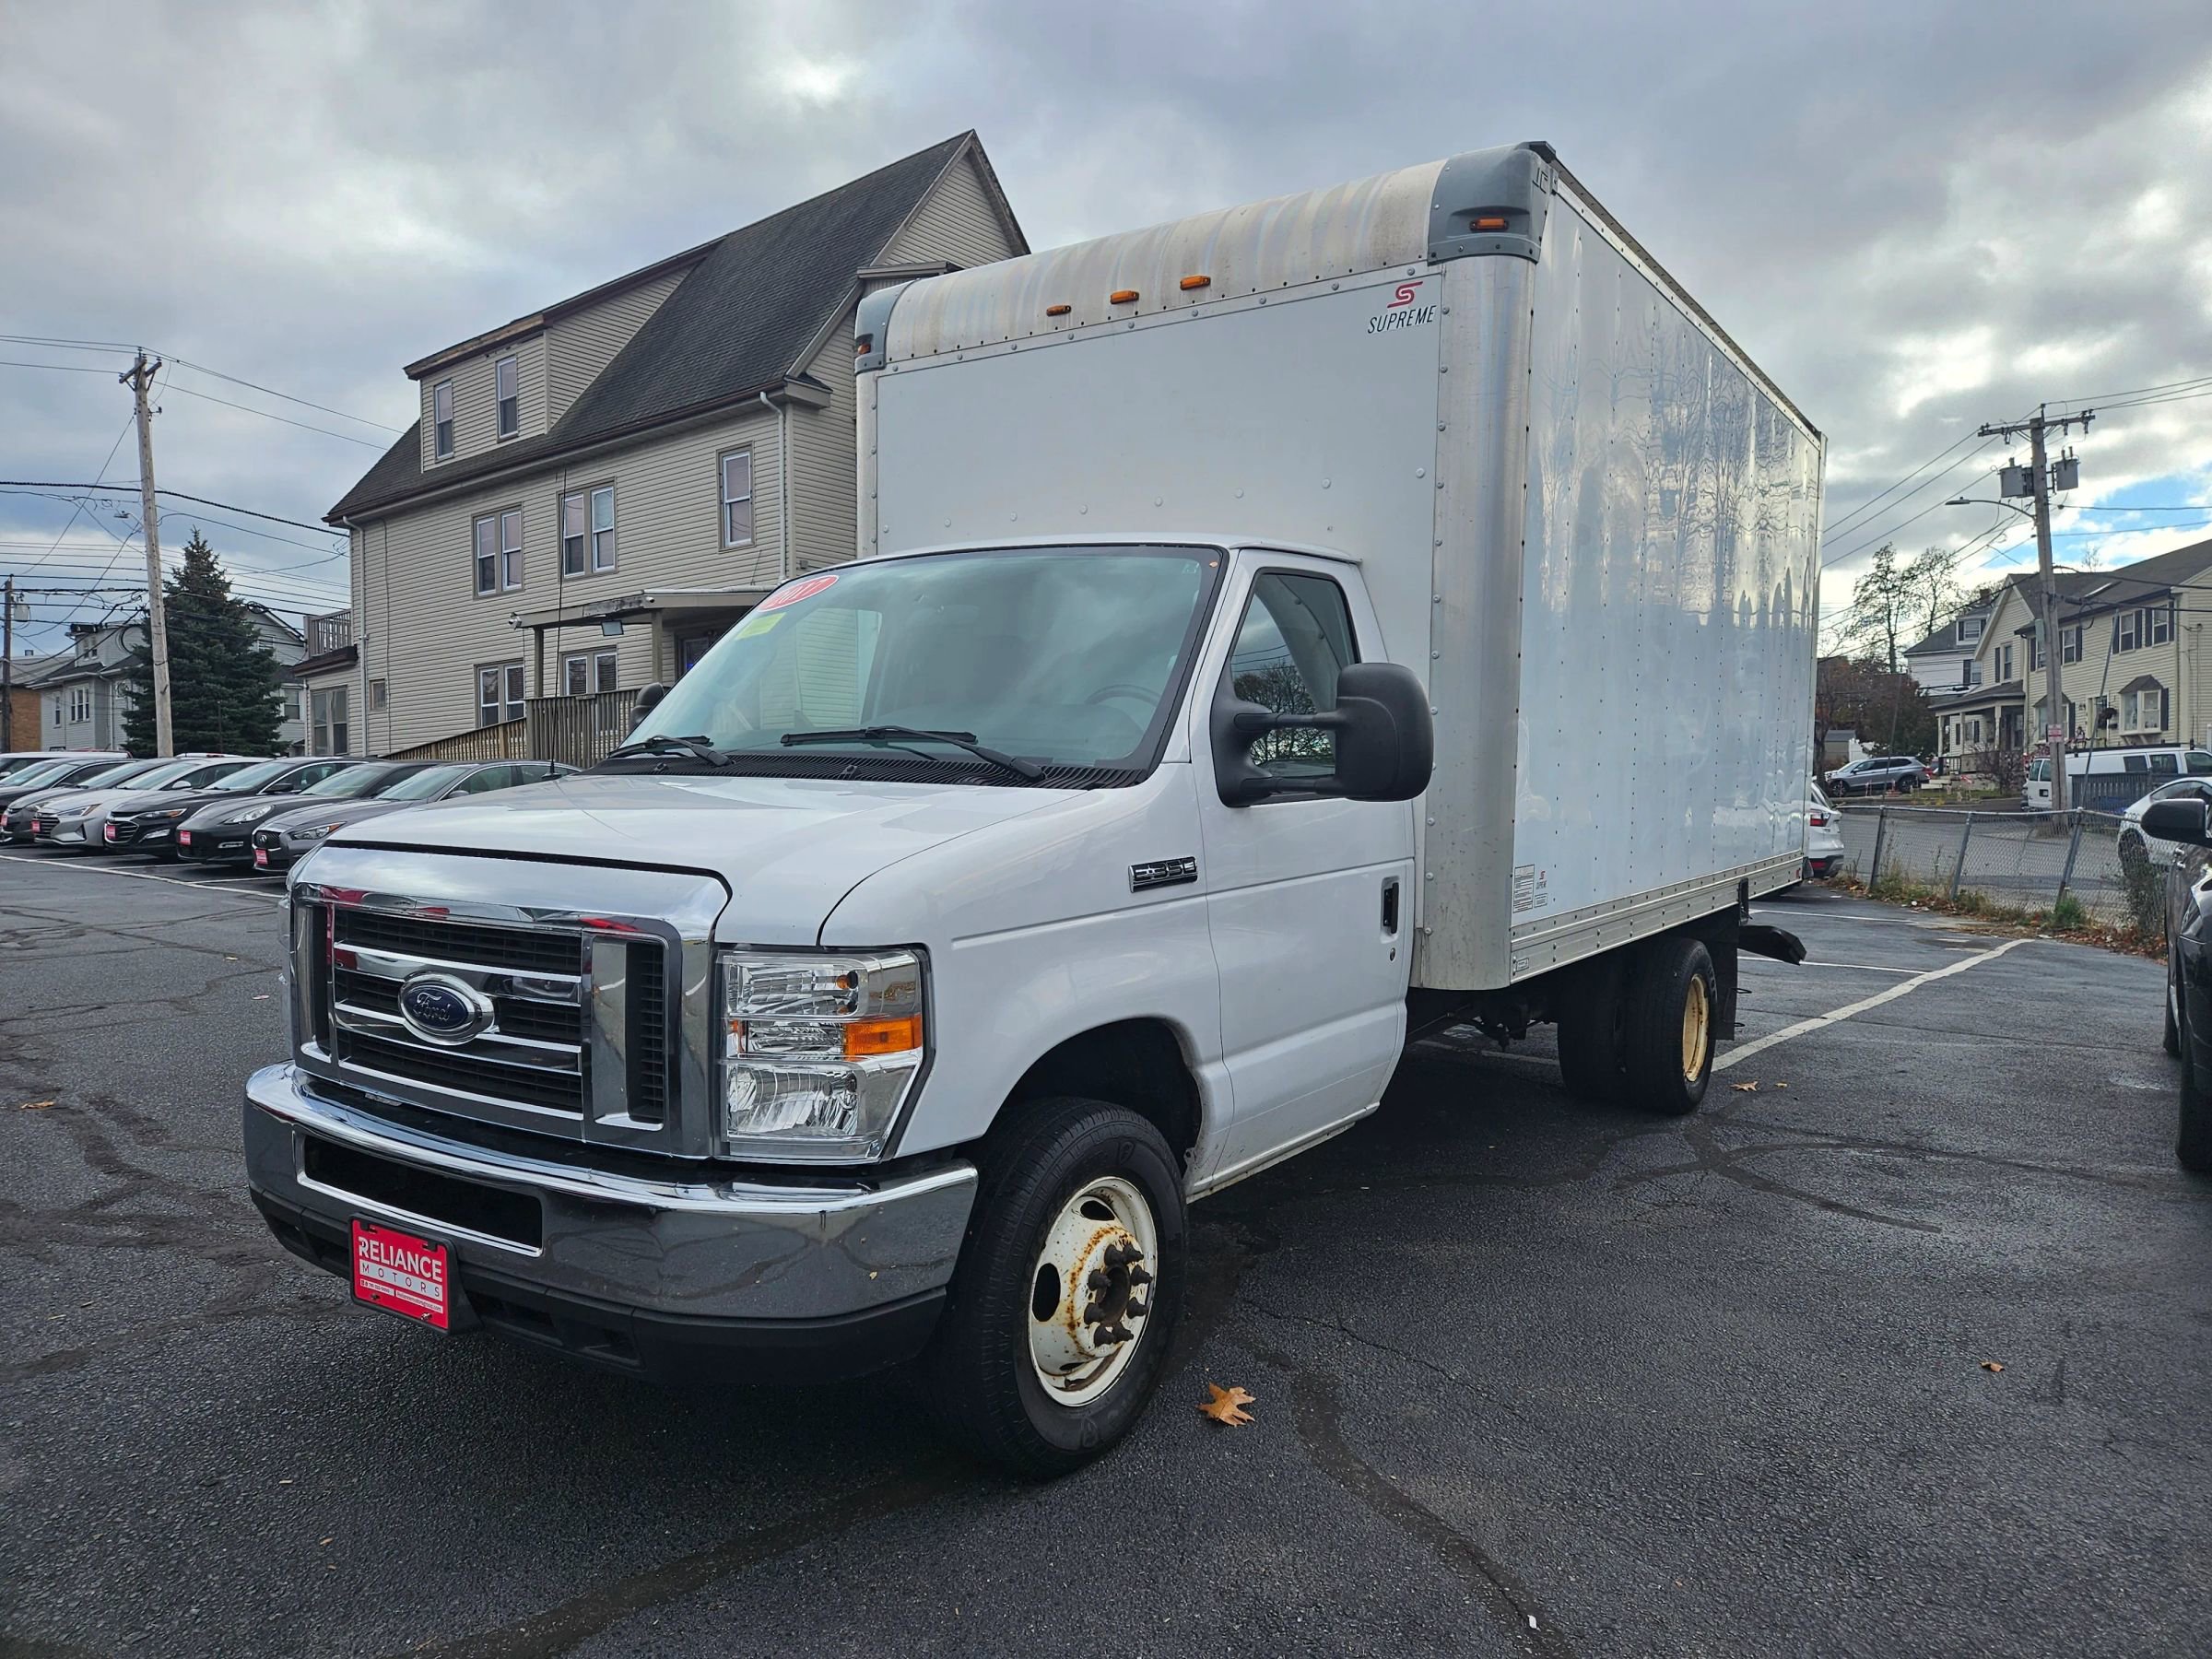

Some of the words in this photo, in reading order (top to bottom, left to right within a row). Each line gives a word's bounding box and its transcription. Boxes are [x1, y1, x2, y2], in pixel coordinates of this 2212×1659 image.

[1367, 305, 1437, 334] SUPREME
[412, 992, 451, 1021] Ford
[358, 1236, 442, 1283] RELIANCE
[362, 1263, 440, 1298] MOTORS
